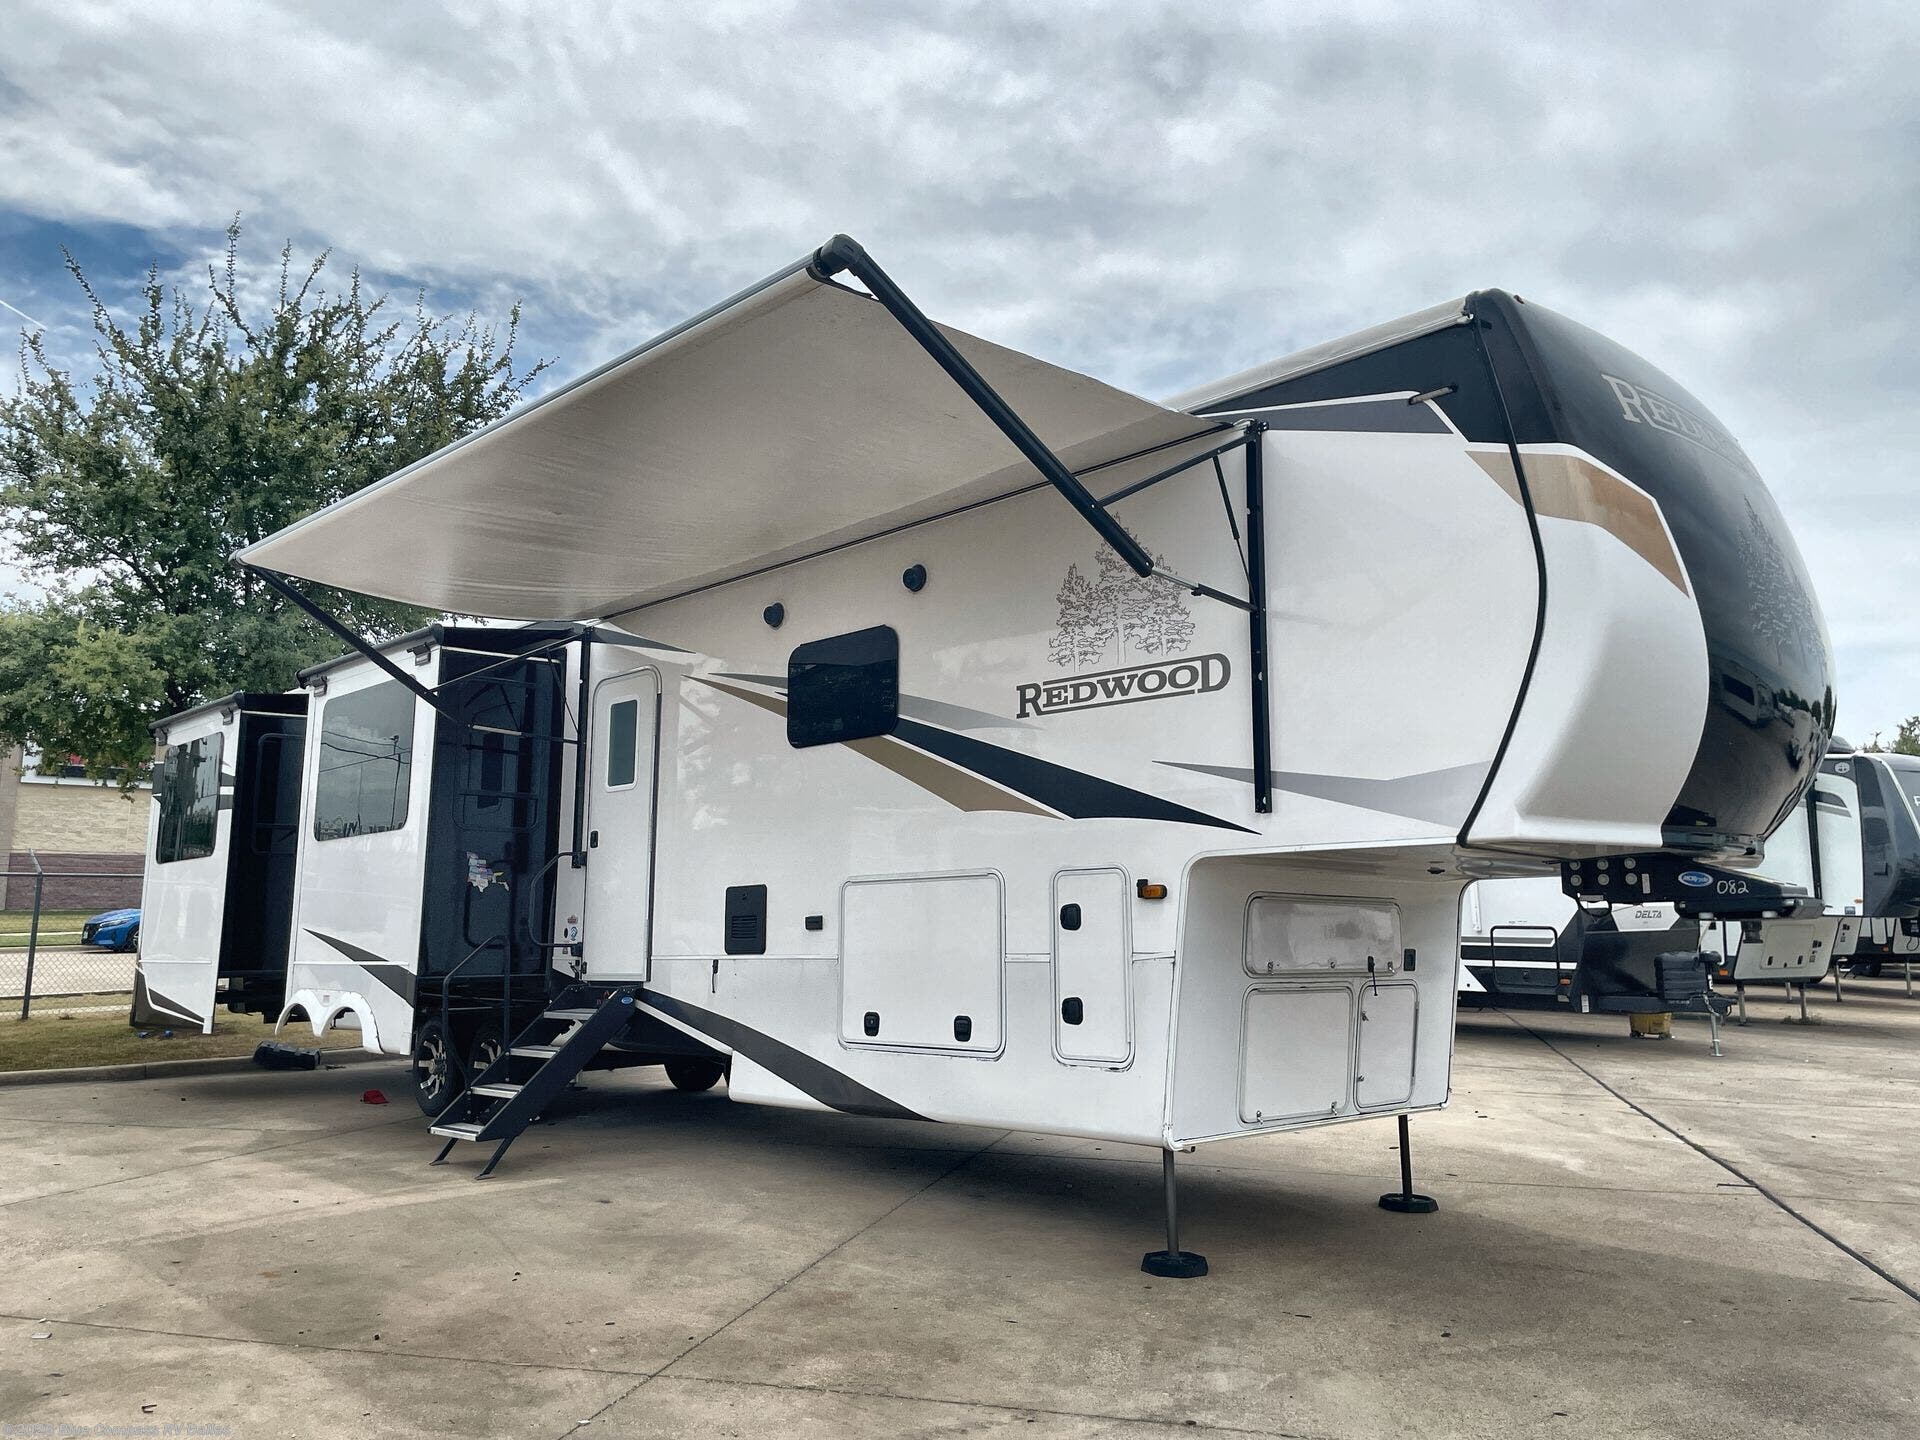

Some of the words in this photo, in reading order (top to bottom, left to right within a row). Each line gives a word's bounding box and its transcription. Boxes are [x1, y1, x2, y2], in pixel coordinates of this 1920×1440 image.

[1016, 652, 1231, 719] REDWOOD
[1716, 879, 1749, 894] 082
[1635, 910, 1662, 919] DELTA
